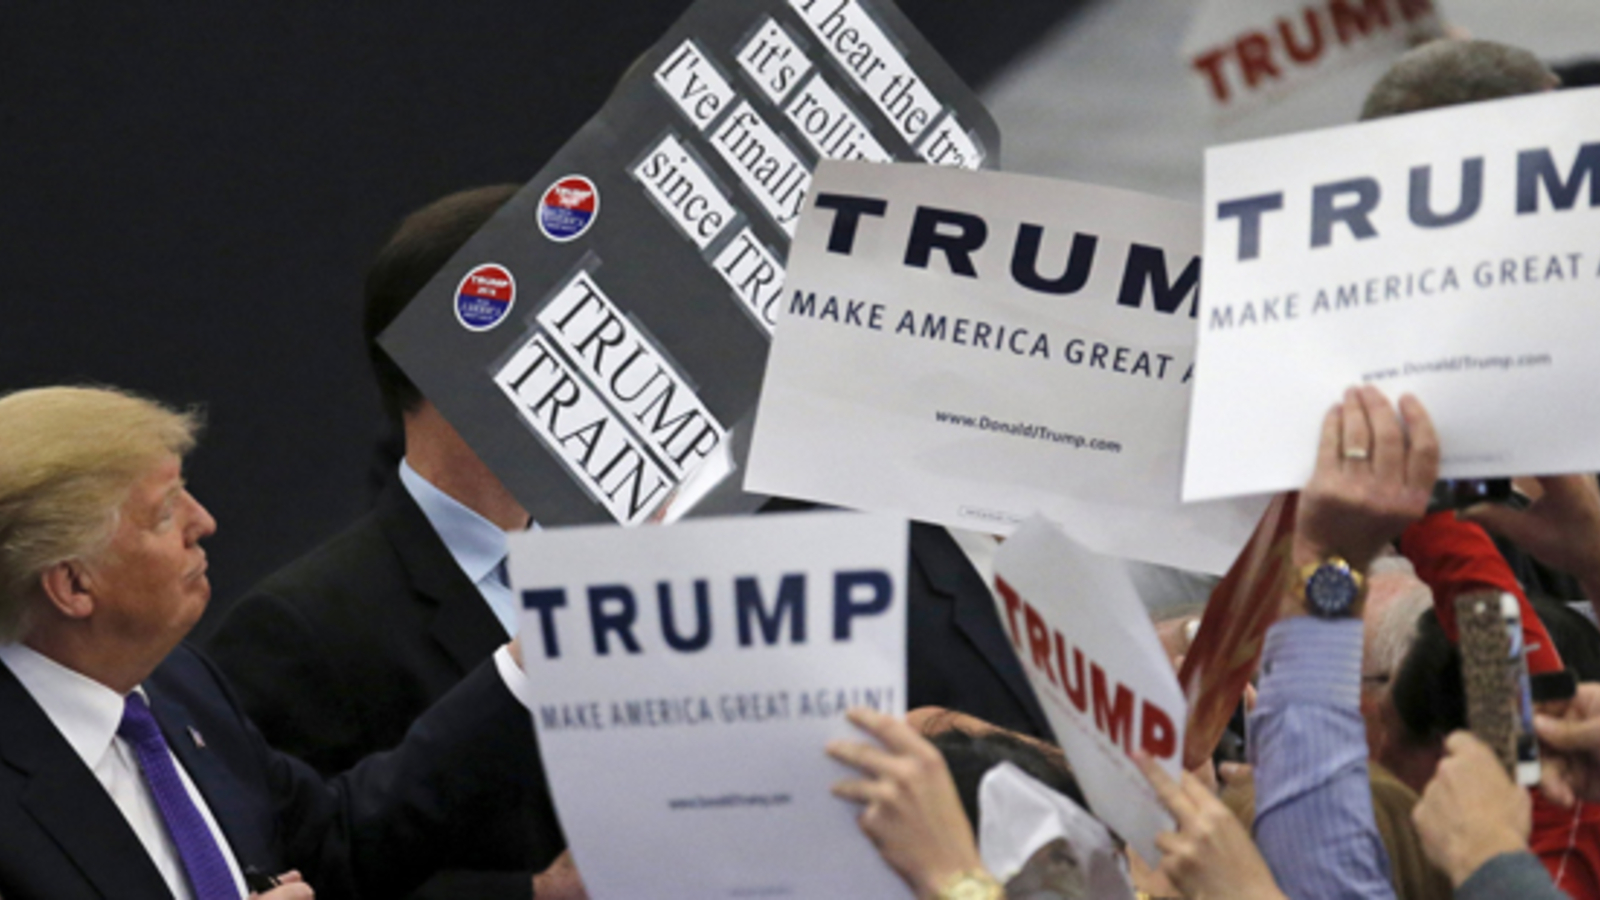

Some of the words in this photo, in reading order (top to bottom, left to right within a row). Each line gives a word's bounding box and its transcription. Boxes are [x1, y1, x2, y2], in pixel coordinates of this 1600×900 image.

[745, 30, 798, 93] it's
[791, 93, 869, 162] rolli
[817, 0, 886, 82] hear
[879, 72, 929, 135] the
[642, 151, 723, 238] since
[659, 45, 720, 120] I've
[718, 111, 799, 223] finally
[814, 192, 1202, 319] TRUM
[1216, 141, 1600, 262] TRUM
[788, 289, 887, 331] MAKE
[895, 309, 1050, 359] AMERICA
[1064, 337, 1174, 382] GREAT
[1208, 292, 1301, 332] MAKE
[1311, 266, 1461, 315] AMERICA
[1473, 252, 1583, 289] GREAT
[507, 339, 668, 521] TRAIN
[552, 278, 721, 470] TRUMP
[520, 569, 894, 659] TRUMP
[994, 571, 1177, 760] TRUMP
[538, 700, 606, 731] MAKE
[609, 696, 715, 729] AMERICA
[719, 691, 792, 724] GREAT
